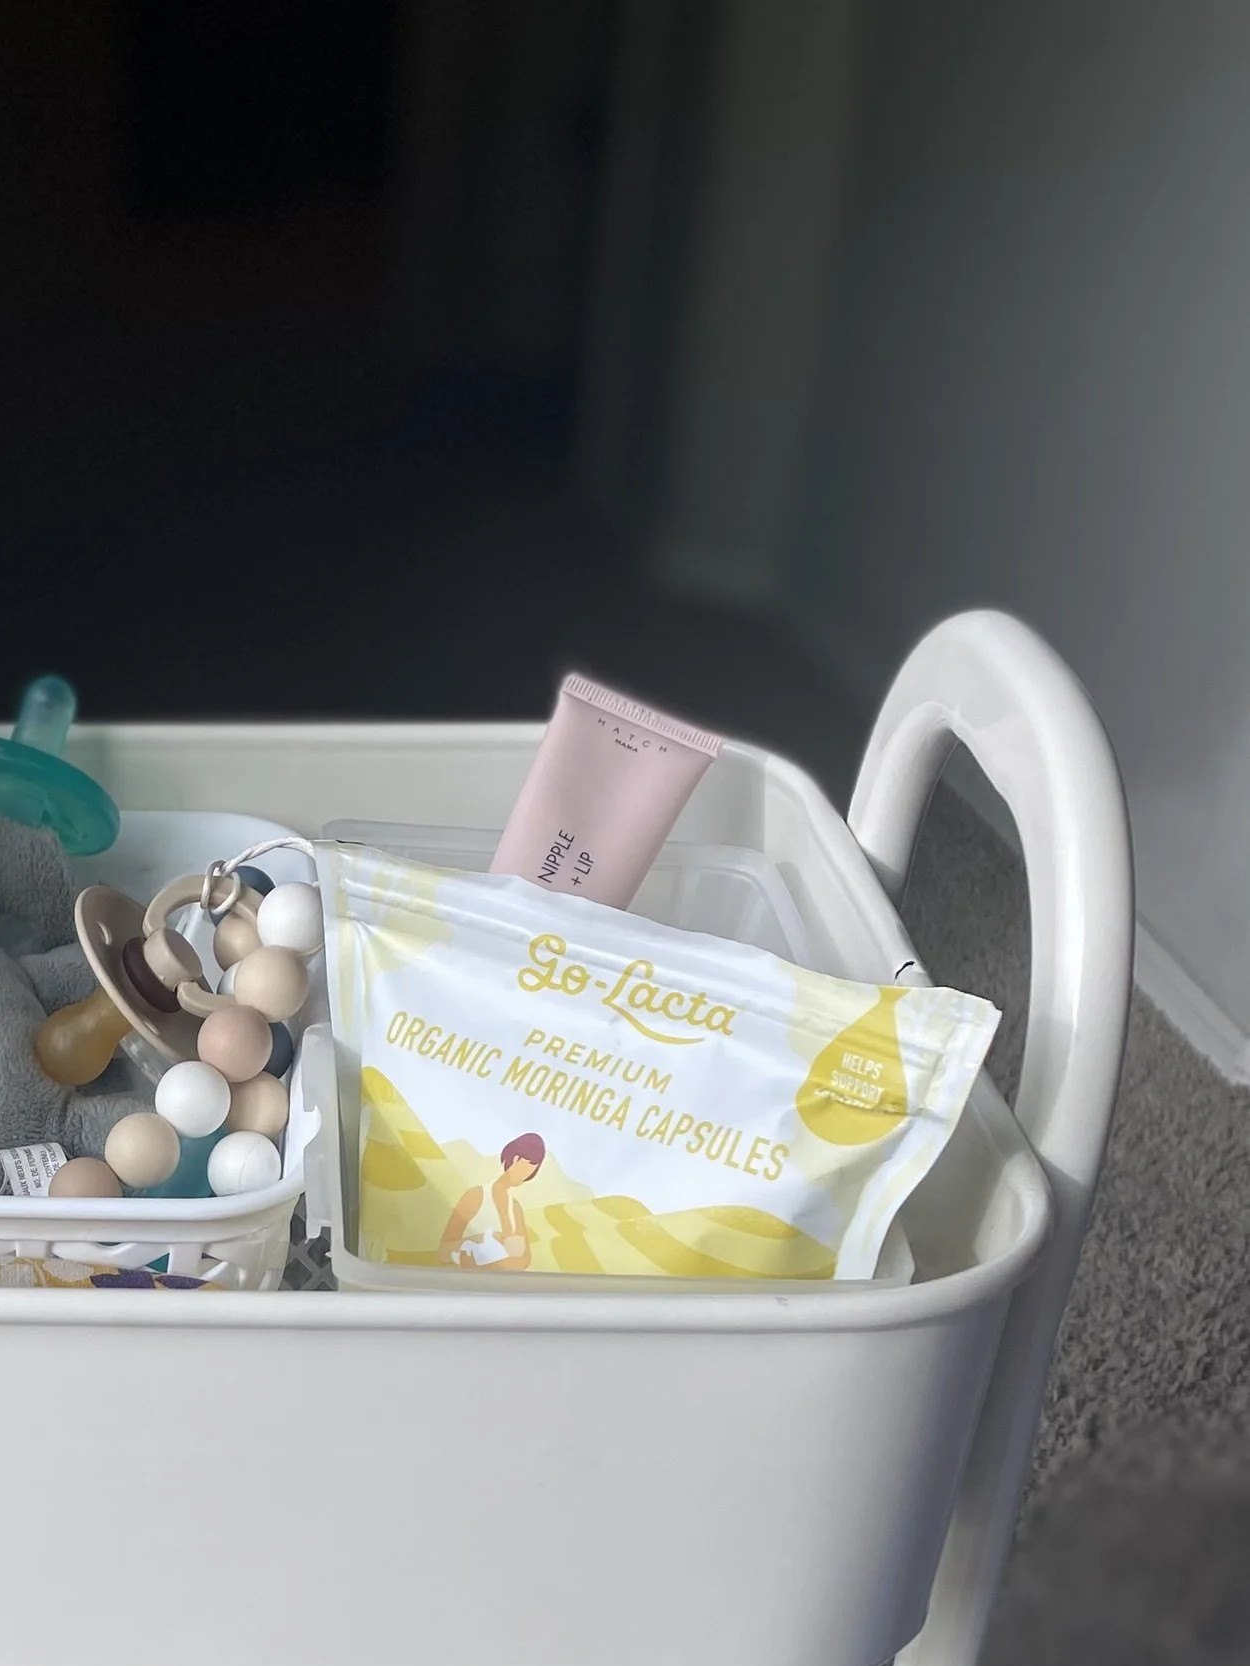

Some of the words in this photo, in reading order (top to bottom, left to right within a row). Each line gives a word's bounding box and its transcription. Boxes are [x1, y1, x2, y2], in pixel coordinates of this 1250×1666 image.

[598, 717, 668, 753] HATCH
[615, 738, 638, 753] MAMA
[536, 828, 575, 884] NIPPLE
[573, 851, 594, 875] LIP
[517, 934, 737, 1045] Go-Lacta
[523, 1028, 673, 1095] PREMIUM
[841, 1051, 884, 1080] HELPS
[386, 1010, 502, 1079] ORGANIC
[500, 1055, 632, 1132] MORINGA
[635, 1104, 790, 1182] CAPSULES
[830, 1069, 885, 1105] SUPPORT
